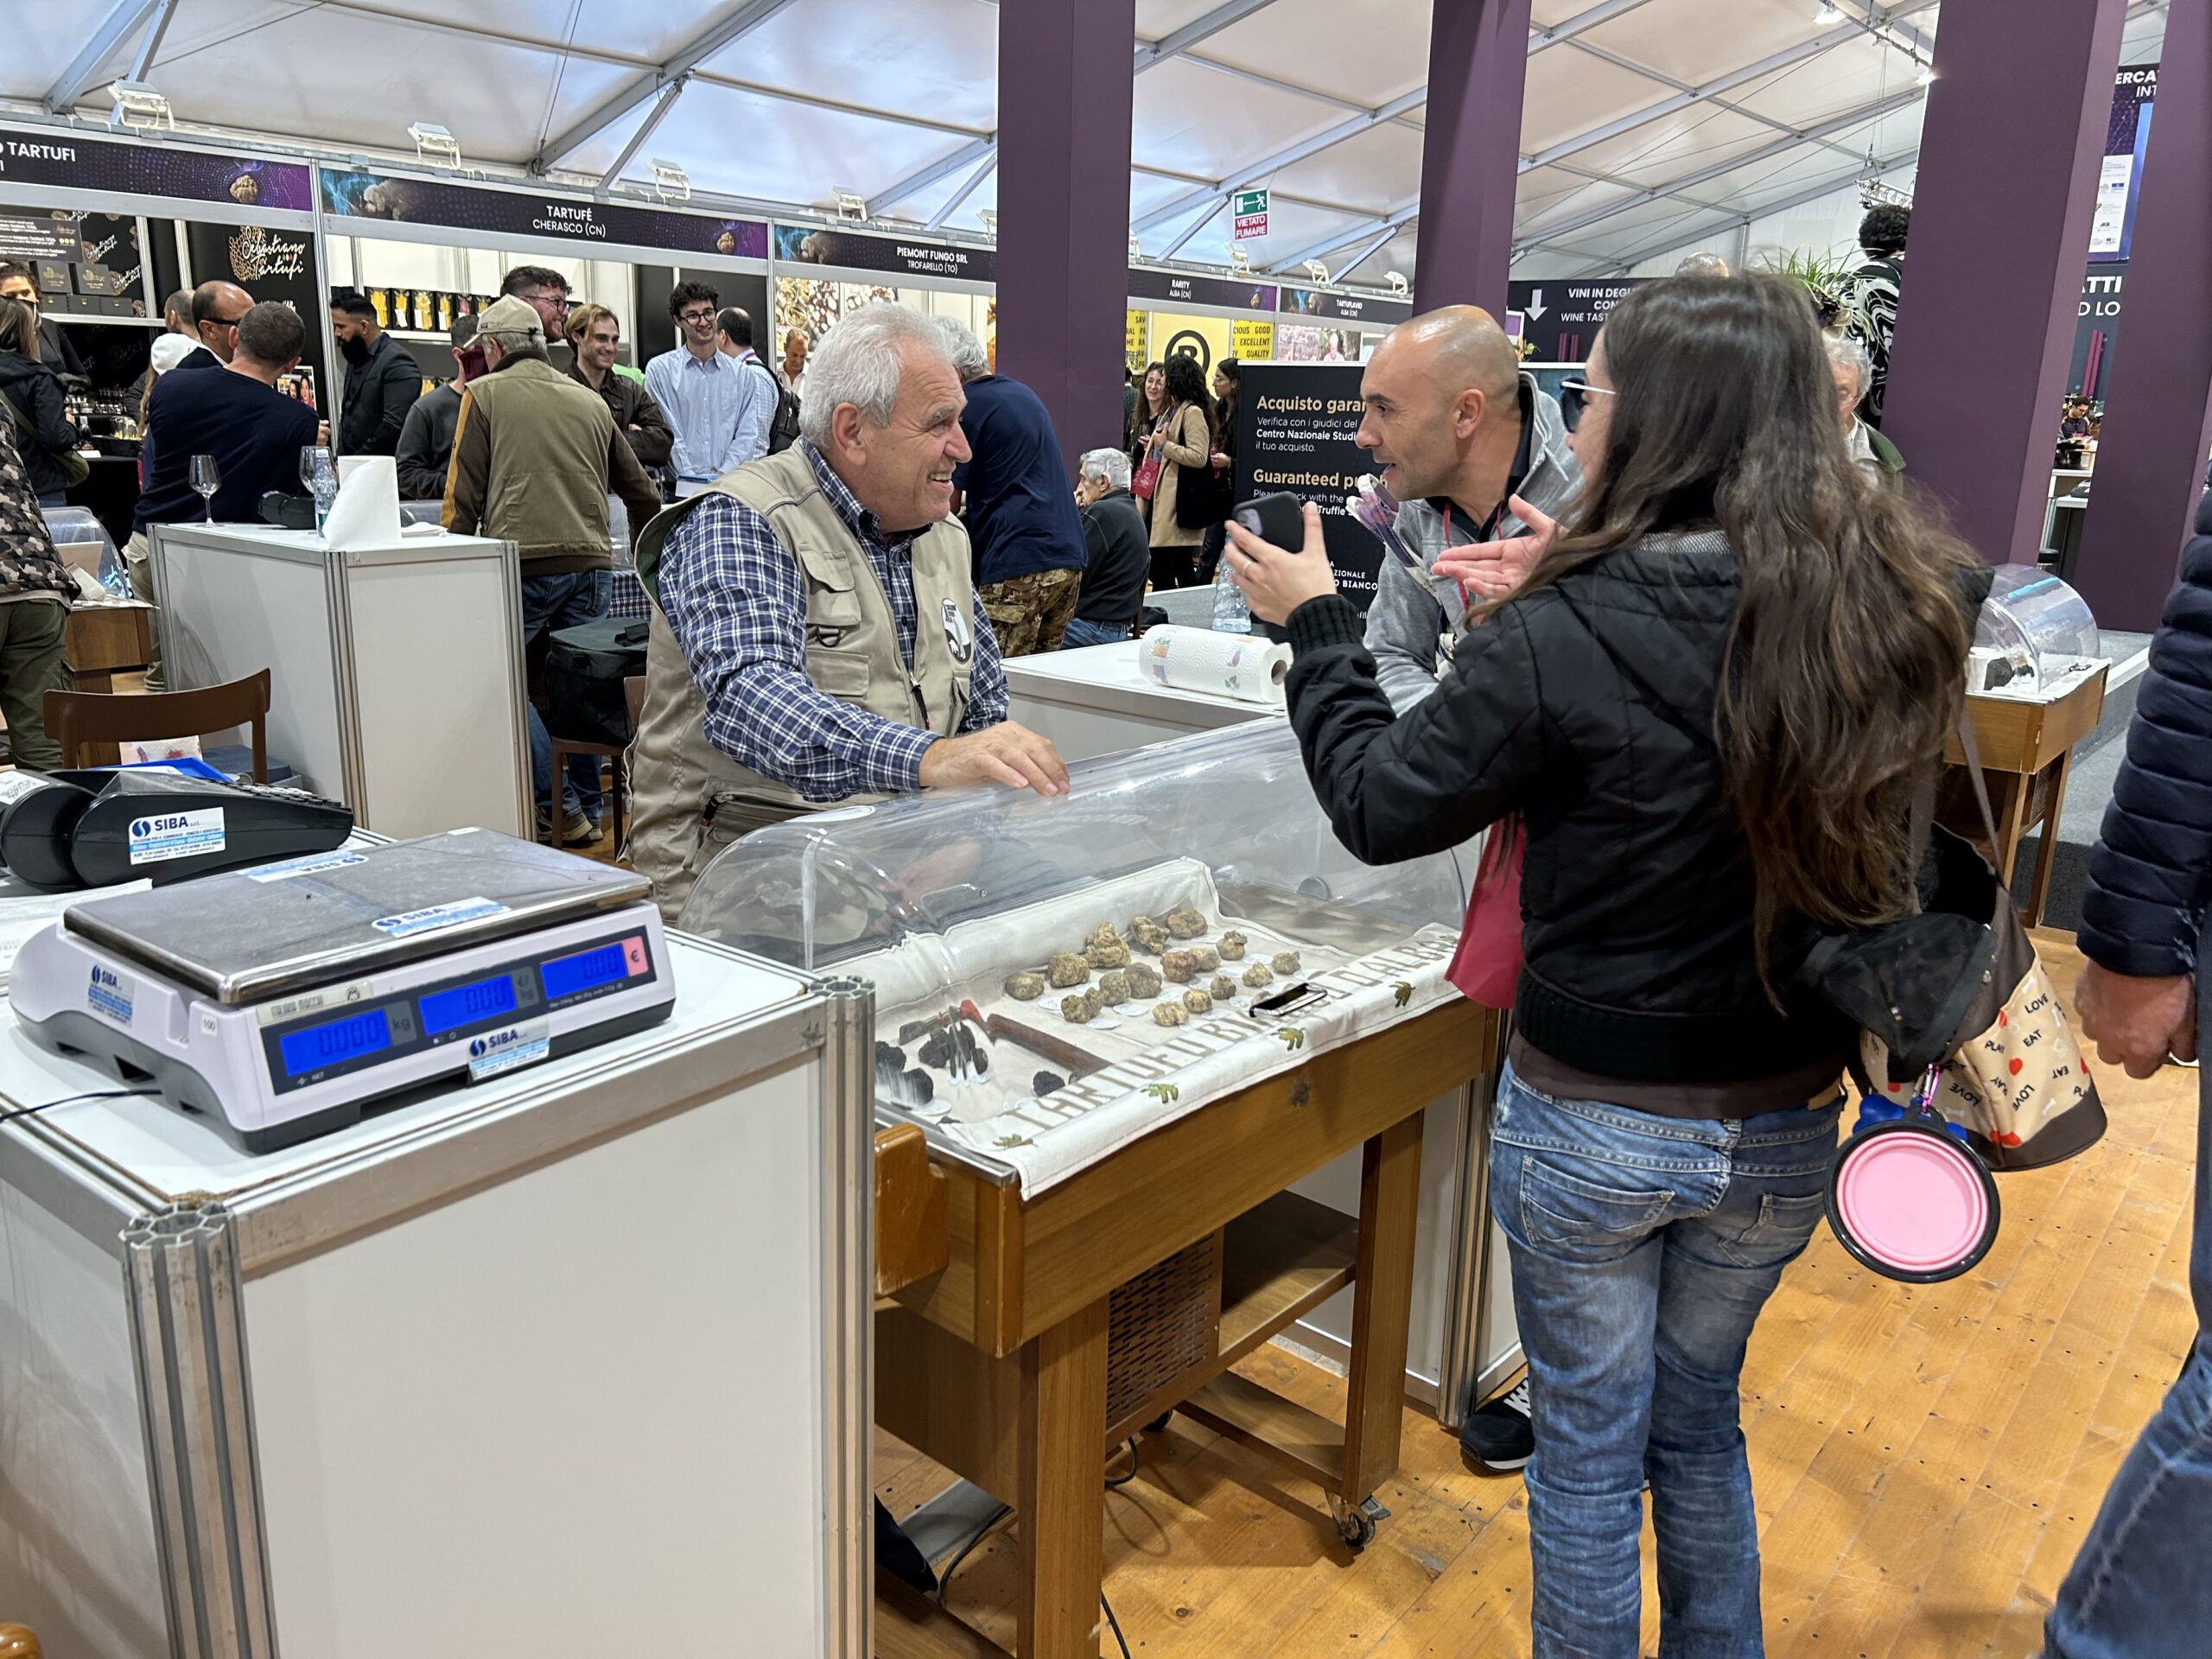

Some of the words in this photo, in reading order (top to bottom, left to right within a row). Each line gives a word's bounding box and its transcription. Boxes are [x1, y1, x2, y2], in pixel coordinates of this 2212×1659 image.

[2114, 69, 2159, 85] ERCA
[6, 141, 76, 162] TARTUFI
[546, 205, 593, 222] TARTUFÉ
[1236, 215, 1266, 228] VIETATO
[532, 219, 583, 233] CHERASCO
[585, 222, 607, 238] (CN)
[1236, 225, 1267, 238] FUMARE
[896, 246, 929, 259] PIEMONT
[930, 250, 955, 263] FUNGO
[956, 254, 968, 264] SRL
[907, 259, 944, 272] TROFARELLO
[944, 262, 958, 275] (TO)
[1171, 279, 1191, 289] RARITY
[1169, 289, 1180, 298] ALBA
[1567, 288, 1590, 299] VINI
[1592, 289, 1603, 299] IN
[1560, 313, 1584, 322] WINE
[1255, 326, 1271, 334] GOOD
[1240, 338, 1270, 346] EXCELLENT
[1246, 349, 1270, 359] QUALITY
[1256, 395, 1323, 413] Acquisto
[1257, 416, 1288, 427] Verifica
[1290, 418, 1306, 427] con
[1313, 417, 1341, 429] giudici
[1344, 418, 1358, 428] del
[1256, 429, 1286, 439] Centro
[1287, 429, 1331, 441] Nazionale
[1332, 431, 1357, 442] Studi
[1255, 441, 1261, 450] il
[1262, 442, 1277, 451] tuo
[1278, 441, 1317, 453] acquisto.
[1253, 468, 1339, 487] Guaranteed
[1308, 493, 1327, 503] with
[1329, 493, 1344, 504] the
[1318, 505, 1345, 517] Truffle
[1333, 569, 1366, 580] ZIONALE
[1342, 579, 1378, 591] BIANCO
[154, 816, 188, 831] SIBA
[402, 907, 448, 920] SIBA
[630, 949, 640, 963] €
[101, 969, 118, 988] SIBA
[2024, 993, 2049, 1014] LOVE
[203, 1019, 216, 1031] 100
[391, 1015, 411, 1032] kg
[488, 1028, 518, 1049] SIBA
[2022, 1028, 2043, 1047] EAT
[2051, 1065, 2069, 1079] EAT
[1948, 1082, 1982, 1107] LOVE
[2012, 1084, 2036, 1112] LOVE
